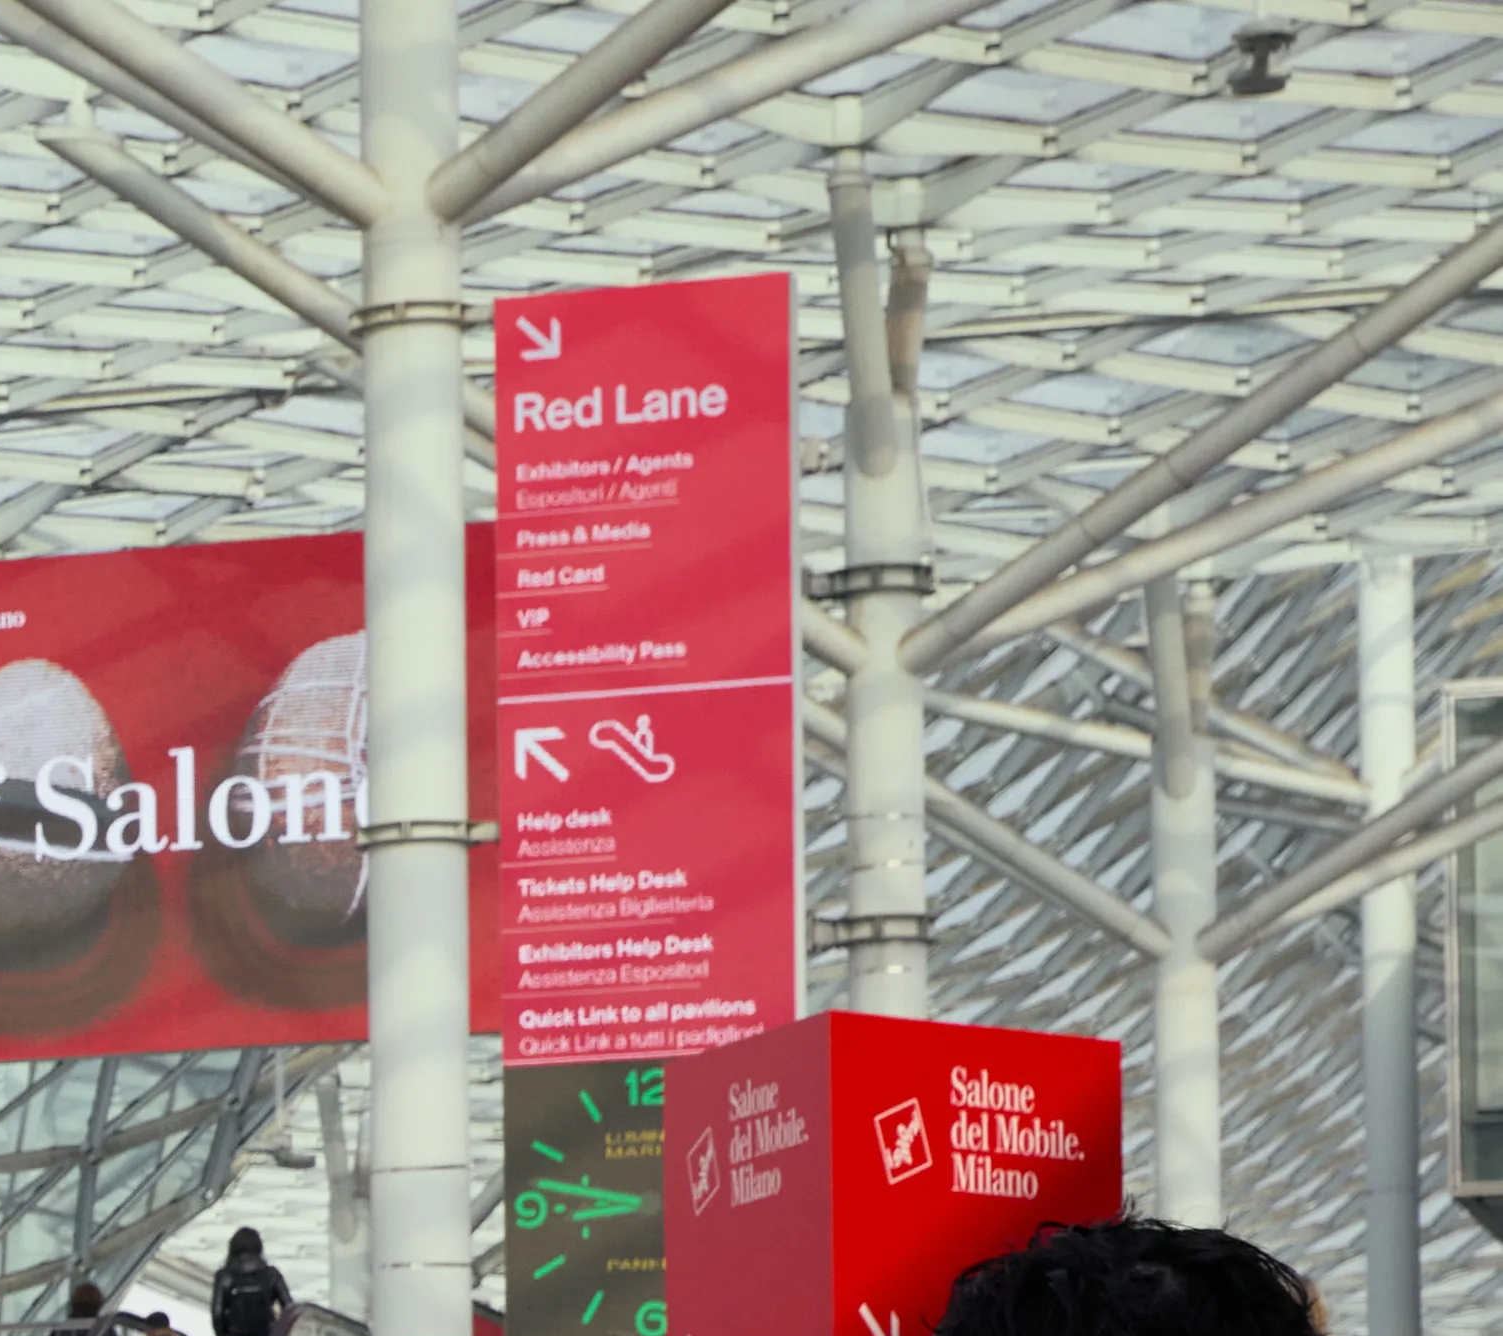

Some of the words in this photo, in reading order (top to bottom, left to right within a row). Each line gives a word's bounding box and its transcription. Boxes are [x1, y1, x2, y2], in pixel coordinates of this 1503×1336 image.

[515, 387, 603, 432] Red
[616, 384, 727, 424] Lane
[516, 526, 569, 549] Press
[573, 527, 587, 543] &
[592, 522, 650, 542] Media
[518, 569, 553, 588] Red
[558, 566, 604, 585] Card
[517, 608, 549, 629] VIP
[517, 643, 635, 670] Accessibility
[641, 641, 686, 660] Pass
[35, 746, 368, 862] Salon
[518, 813, 560, 836] Help
[565, 808, 612, 828] desk
[520, 1009, 574, 1030] Quick
[579, 1007, 618, 1026] Link
[621, 1006, 639, 1023] to
[645, 1003, 667, 1021] all
[672, 999, 756, 1024] pavilions
[625, 1069, 664, 1106] 12
[729, 1079, 779, 1121] Salone
[951, 1066, 1035, 1114] Salone
[730, 1122, 753, 1163] del
[756, 1109, 809, 1157] Mobile.
[951, 1116, 990, 1152] del
[995, 1115, 1085, 1161] Mobile.
[731, 1167, 781, 1207] Milano
[951, 1153, 1038, 1200] Milano
[514, 1193, 548, 1229] 9
